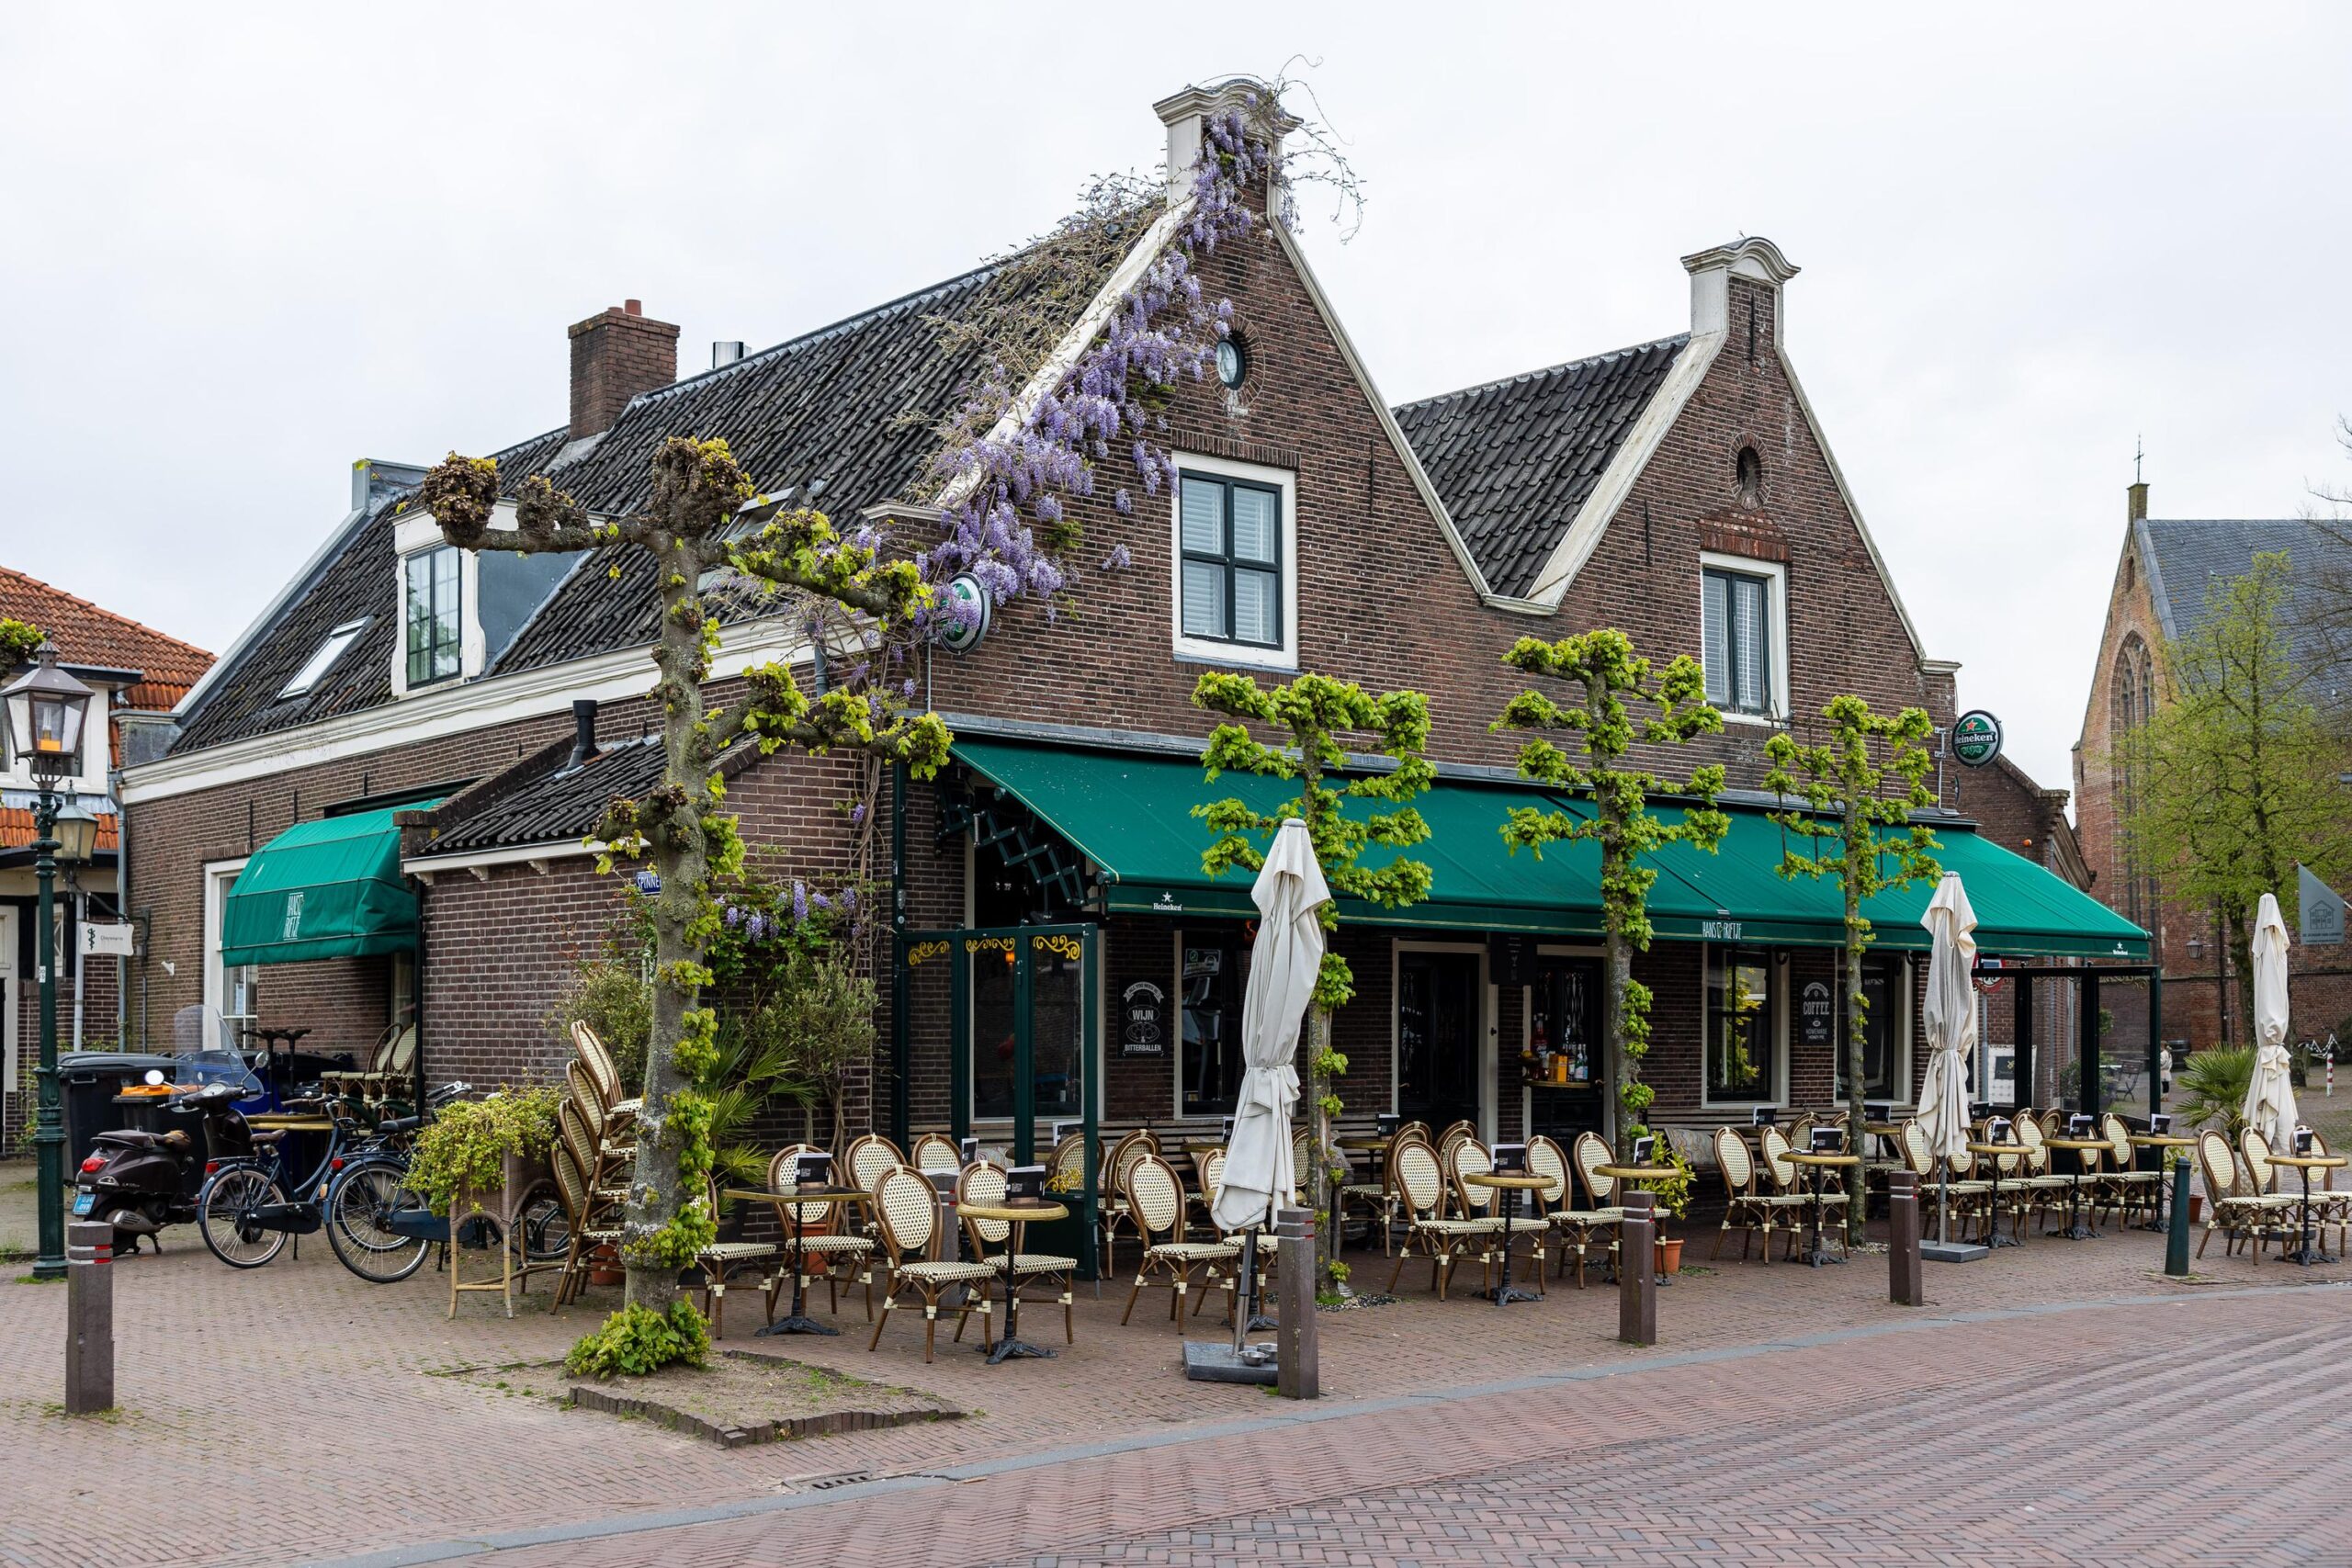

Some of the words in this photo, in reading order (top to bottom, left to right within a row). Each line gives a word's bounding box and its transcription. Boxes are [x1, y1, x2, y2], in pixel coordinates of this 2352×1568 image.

[1153, 903, 1182, 911] Heineken
[1803, 1001, 1829, 1015] COFFEE
[1132, 1010, 1154, 1021] WIJN
[1124, 1043, 1161, 1052] BITTERBALLEN
